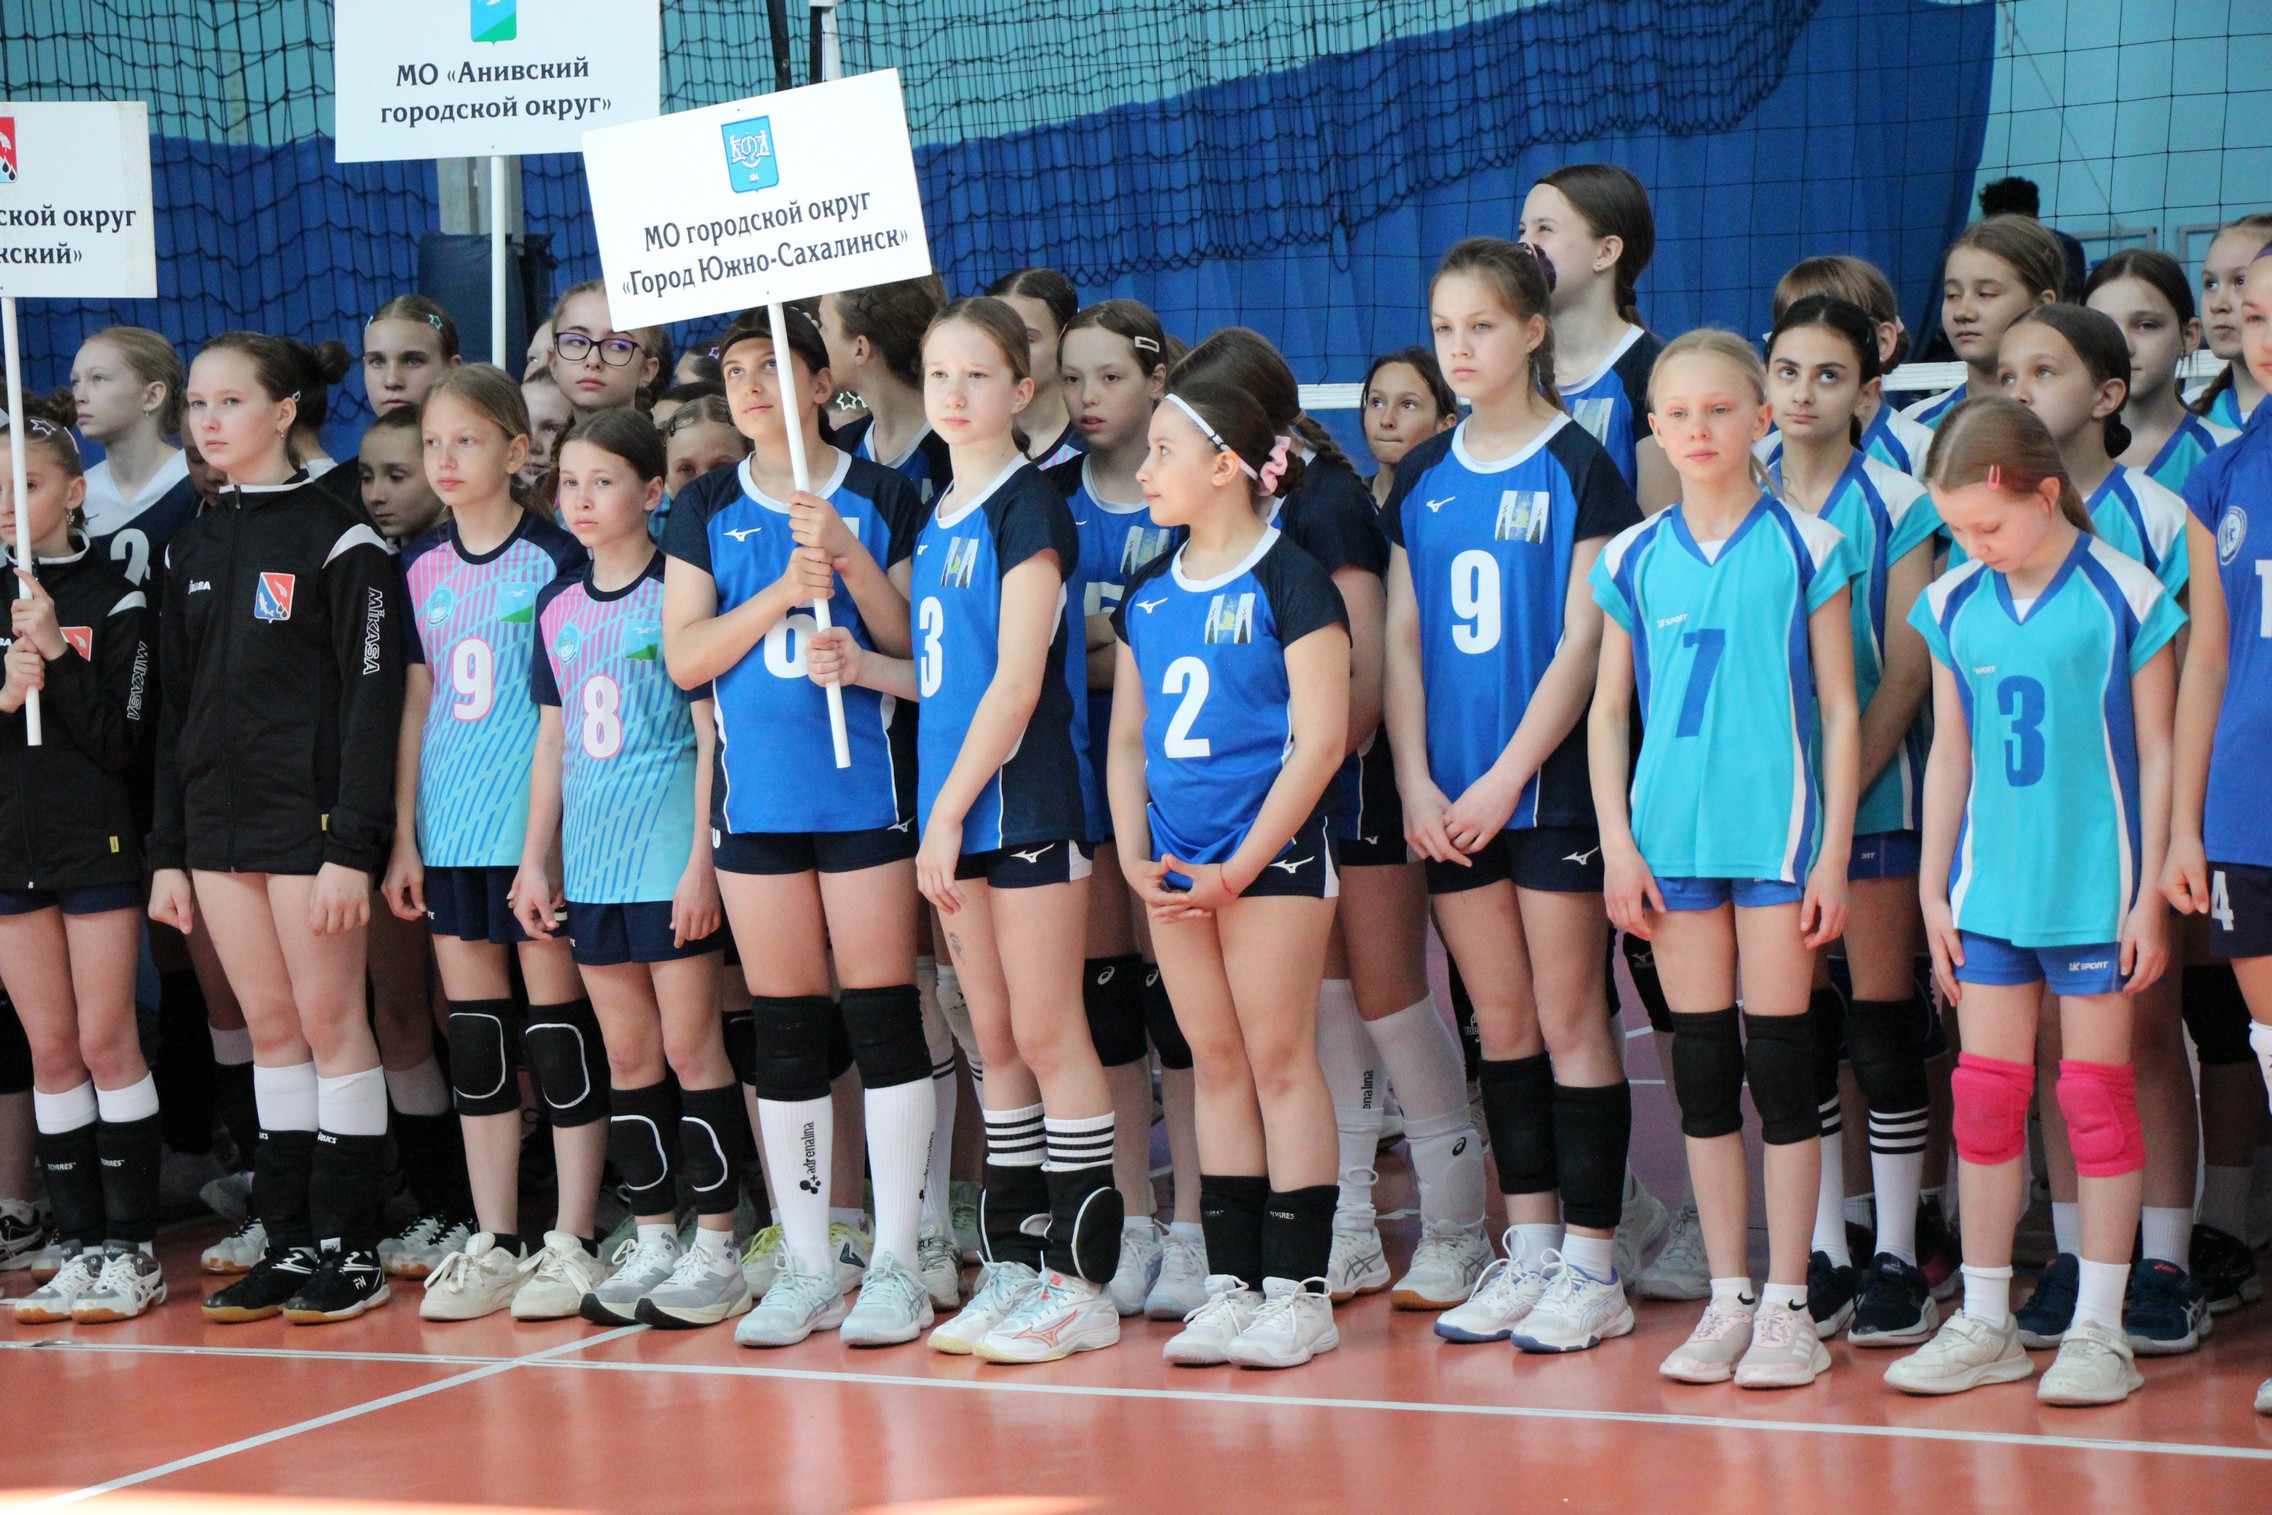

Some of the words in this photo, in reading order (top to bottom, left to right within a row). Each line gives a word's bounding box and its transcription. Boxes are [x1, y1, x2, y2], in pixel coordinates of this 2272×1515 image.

[380, 95, 518, 128] городской
[524, 95, 612, 121] округ»
[396, 62, 439, 87] МО
[447, 55, 590, 84] «Анивский
[63, 209, 137, 234] округ
[622, 267, 696, 296] «Город
[697, 227, 909, 283] Южно-Сахалинск»
[644, 221, 681, 252] МО
[685, 200, 804, 247] городской
[808, 191, 871, 224] округ
[1450, 549, 1502, 655] 9
[451, 636, 494, 723] 9
[919, 596, 944, 698] 3
[1675, 628, 1726, 739] 7
[581, 672, 624, 761] 8
[1162, 656, 1211, 759] 2
[1998, 674, 2047, 788] 3
[2210, 870, 2235, 931] 4
